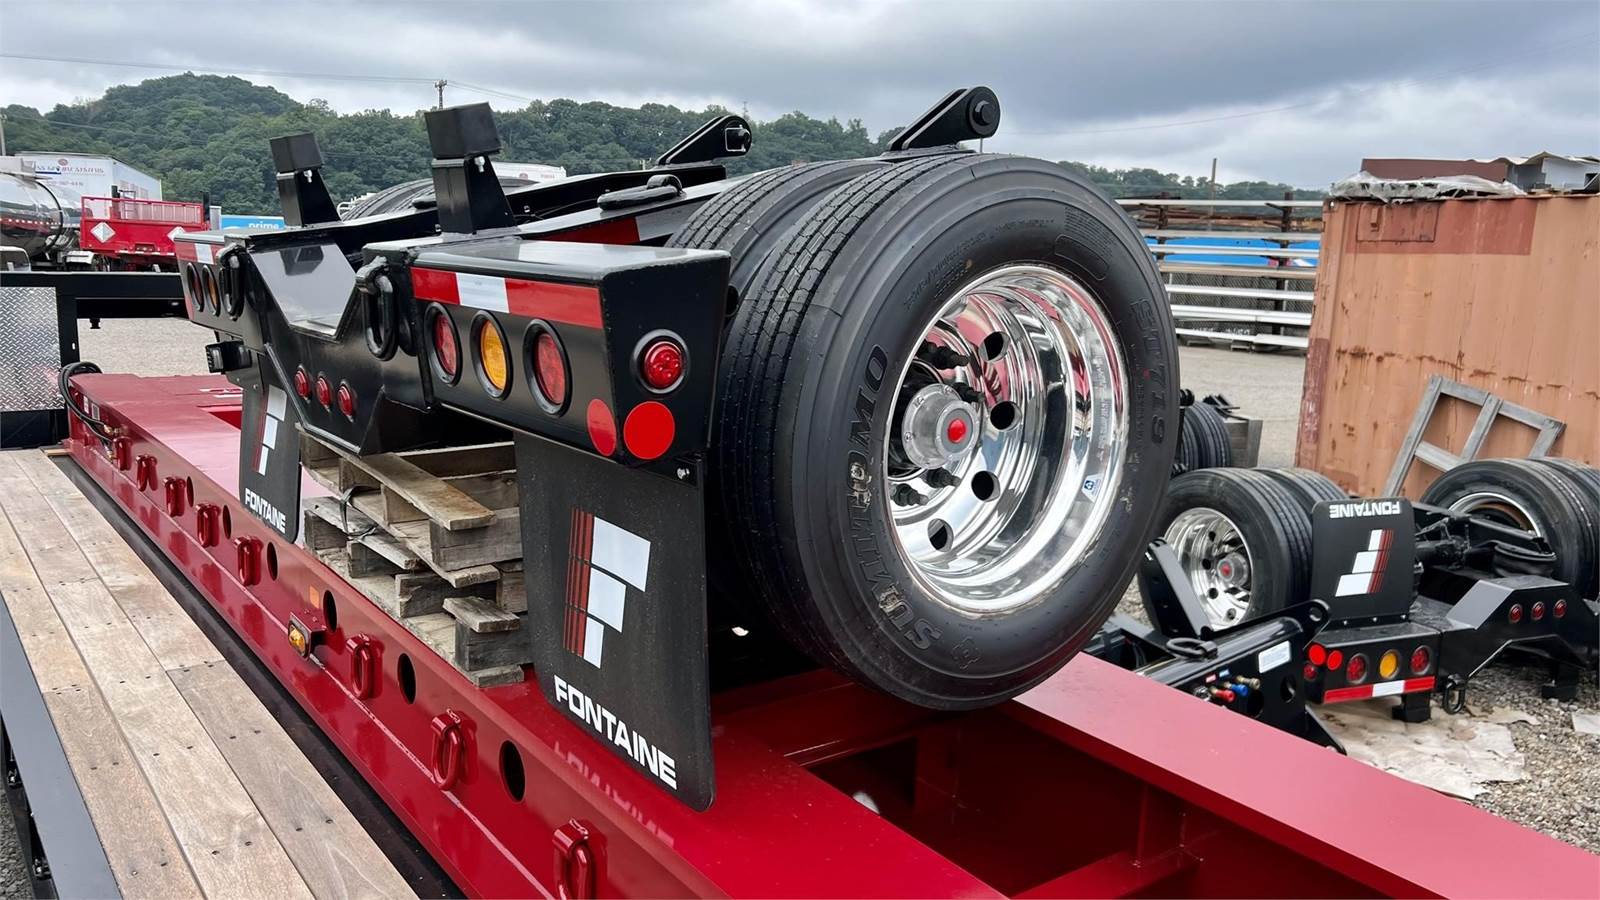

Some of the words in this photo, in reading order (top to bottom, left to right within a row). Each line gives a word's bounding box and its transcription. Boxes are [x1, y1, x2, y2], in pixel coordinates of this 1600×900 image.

[245, 488, 286, 533] FONTAINE
[1329, 501, 1401, 518] FONTAINE
[553, 674, 677, 790] FONTAINE
